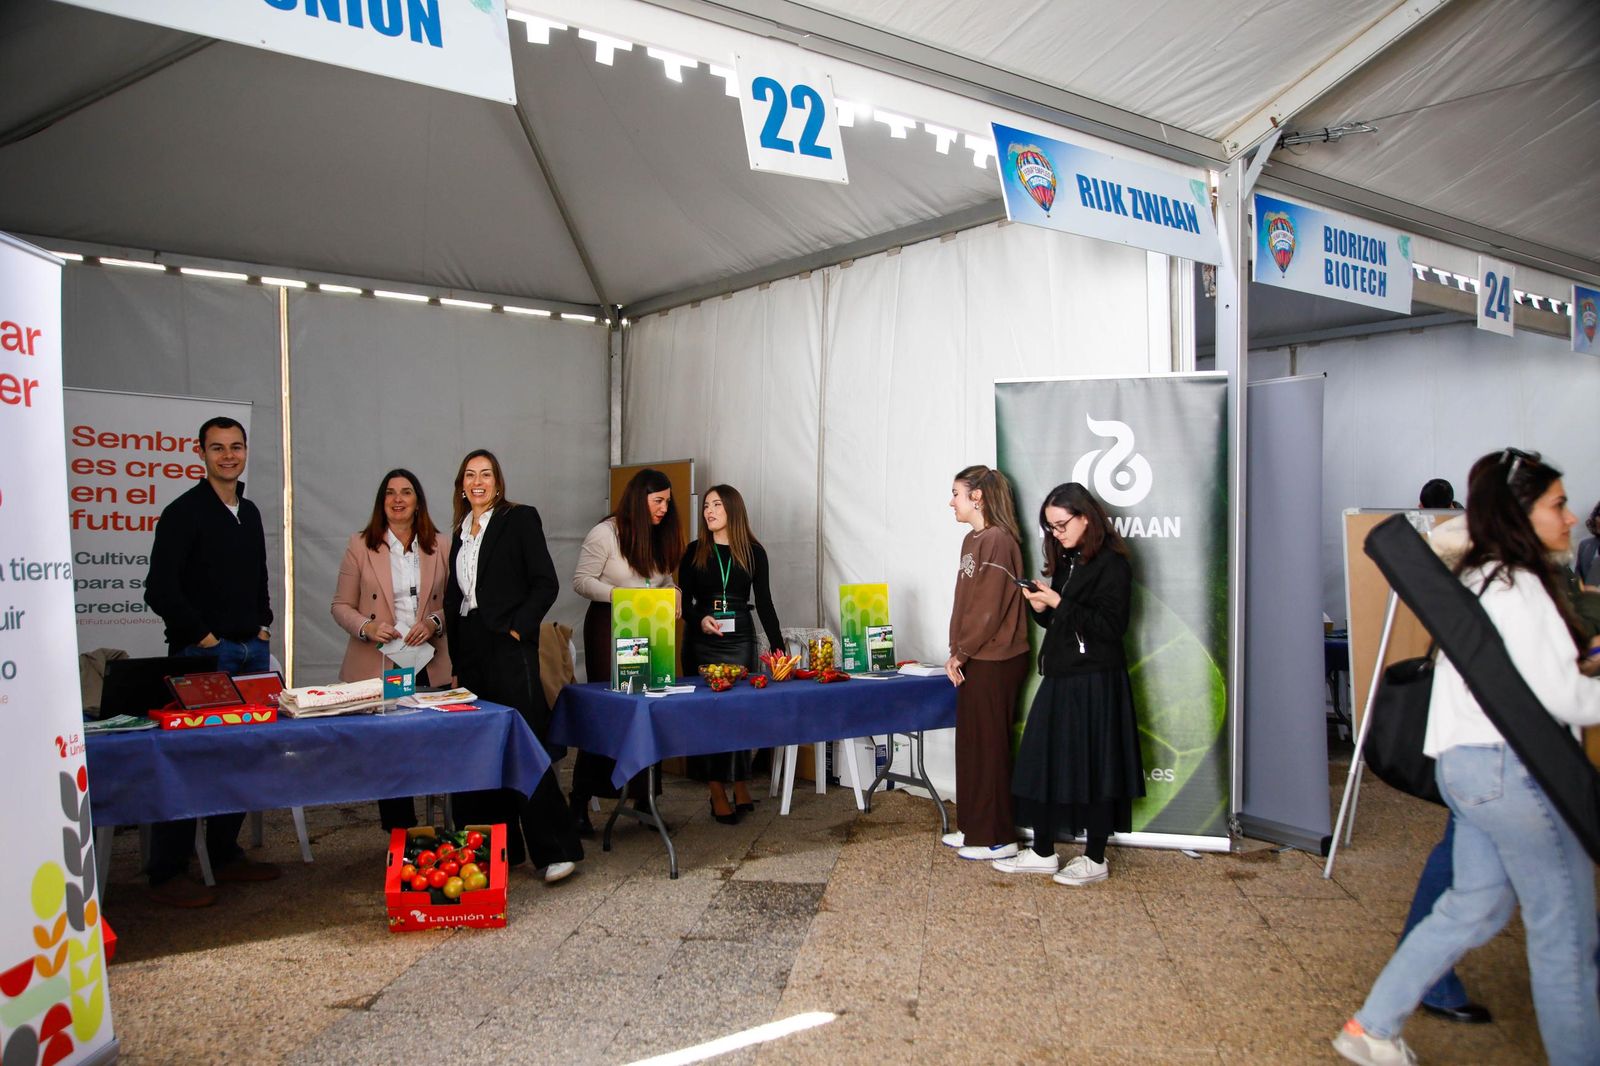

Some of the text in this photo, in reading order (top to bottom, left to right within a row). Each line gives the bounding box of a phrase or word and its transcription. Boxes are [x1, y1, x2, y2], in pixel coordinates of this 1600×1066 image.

[263, 0, 443, 48] ION
[751, 76, 833, 160] 22
[1076, 173, 1201, 234] RIJK ZWAAN
[1323, 225, 1387, 266] BIORIZON
[1324, 257, 1387, 297] BIOTECH
[1485, 271, 1511, 322] 24
[71, 458, 117, 475] es
[71, 484, 156, 504] en el
[10, 557, 73, 581] tierra
[75, 552, 150, 565] Cultiva
[74, 578, 125, 592] para
[1142, 767, 1175, 782] .es
